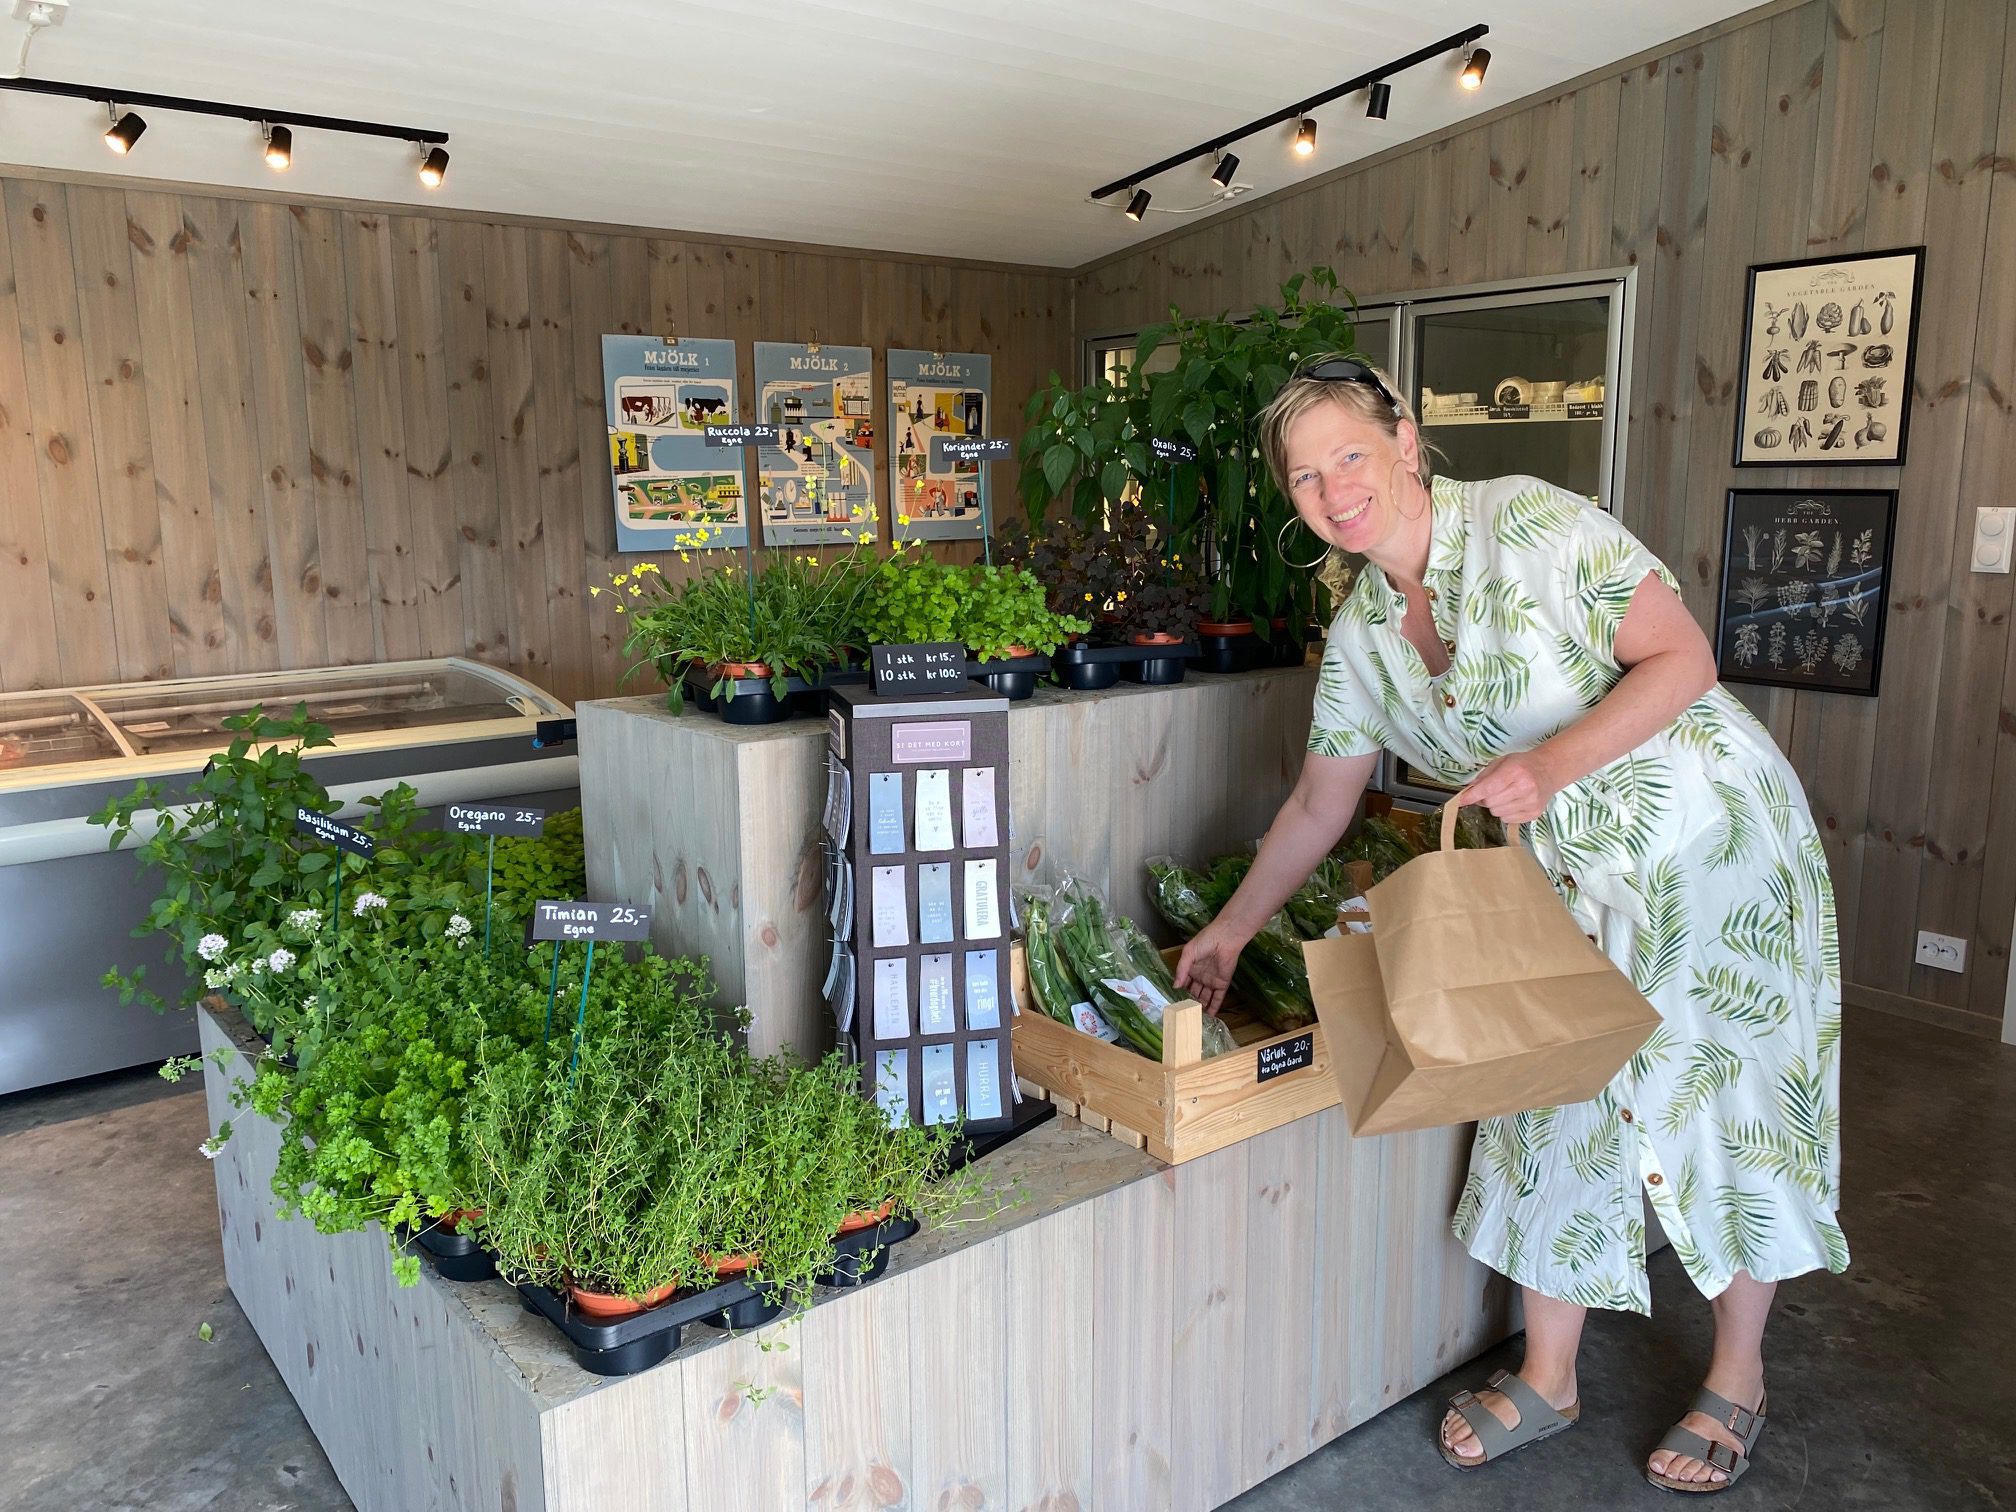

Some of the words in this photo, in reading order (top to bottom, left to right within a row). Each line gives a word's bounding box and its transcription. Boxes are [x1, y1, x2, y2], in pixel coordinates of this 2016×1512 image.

[1787, 287, 1835, 297] VEGETABLE
[1840, 284, 1875, 293] GARDEN
[644, 349, 698, 366] MJÖLK
[705, 358, 710, 366] 1
[790, 356, 838, 371] MJÖLK
[843, 363, 849, 371] 2
[919, 362, 960, 377] MJÖLK
[966, 369, 971, 377] 3
[707, 426, 751, 437] Ruccola
[754, 426, 778, 437] 25,-
[721, 437, 743, 446] Egne
[943, 443, 986, 452] Koriander
[989, 441, 1009, 450] 25,-
[960, 452, 979, 460] Egne
[1152, 438, 1177, 451] Oxalis
[1180, 446, 1196, 460] 25,-
[887, 653, 891, 665] 1
[896, 654, 915, 664] stk
[925, 653, 937, 662] kr
[880, 669, 894, 681] 10
[897, 670, 917, 681] stk
[926, 670, 937, 680] kr
[925, 740, 941, 748] MED
[944, 739, 966, 747] KORT
[449, 806, 506, 822] Oregano
[515, 812, 543, 826] 25,-
[298, 808, 349, 838] Basilikum
[351, 831, 373, 850] 25,-
[458, 821, 482, 831] Egne
[315, 827, 336, 841] Egne
[976, 880, 990, 927] GRATULERA
[541, 905, 598, 922] Timian
[609, 907, 648, 926] 25,-
[563, 924, 595, 938] Egne
[1260, 1046, 1287, 1063] Vårløk
[1271, 1061, 1286, 1074] Ogna
[979, 1061, 993, 1107] HURRA!
